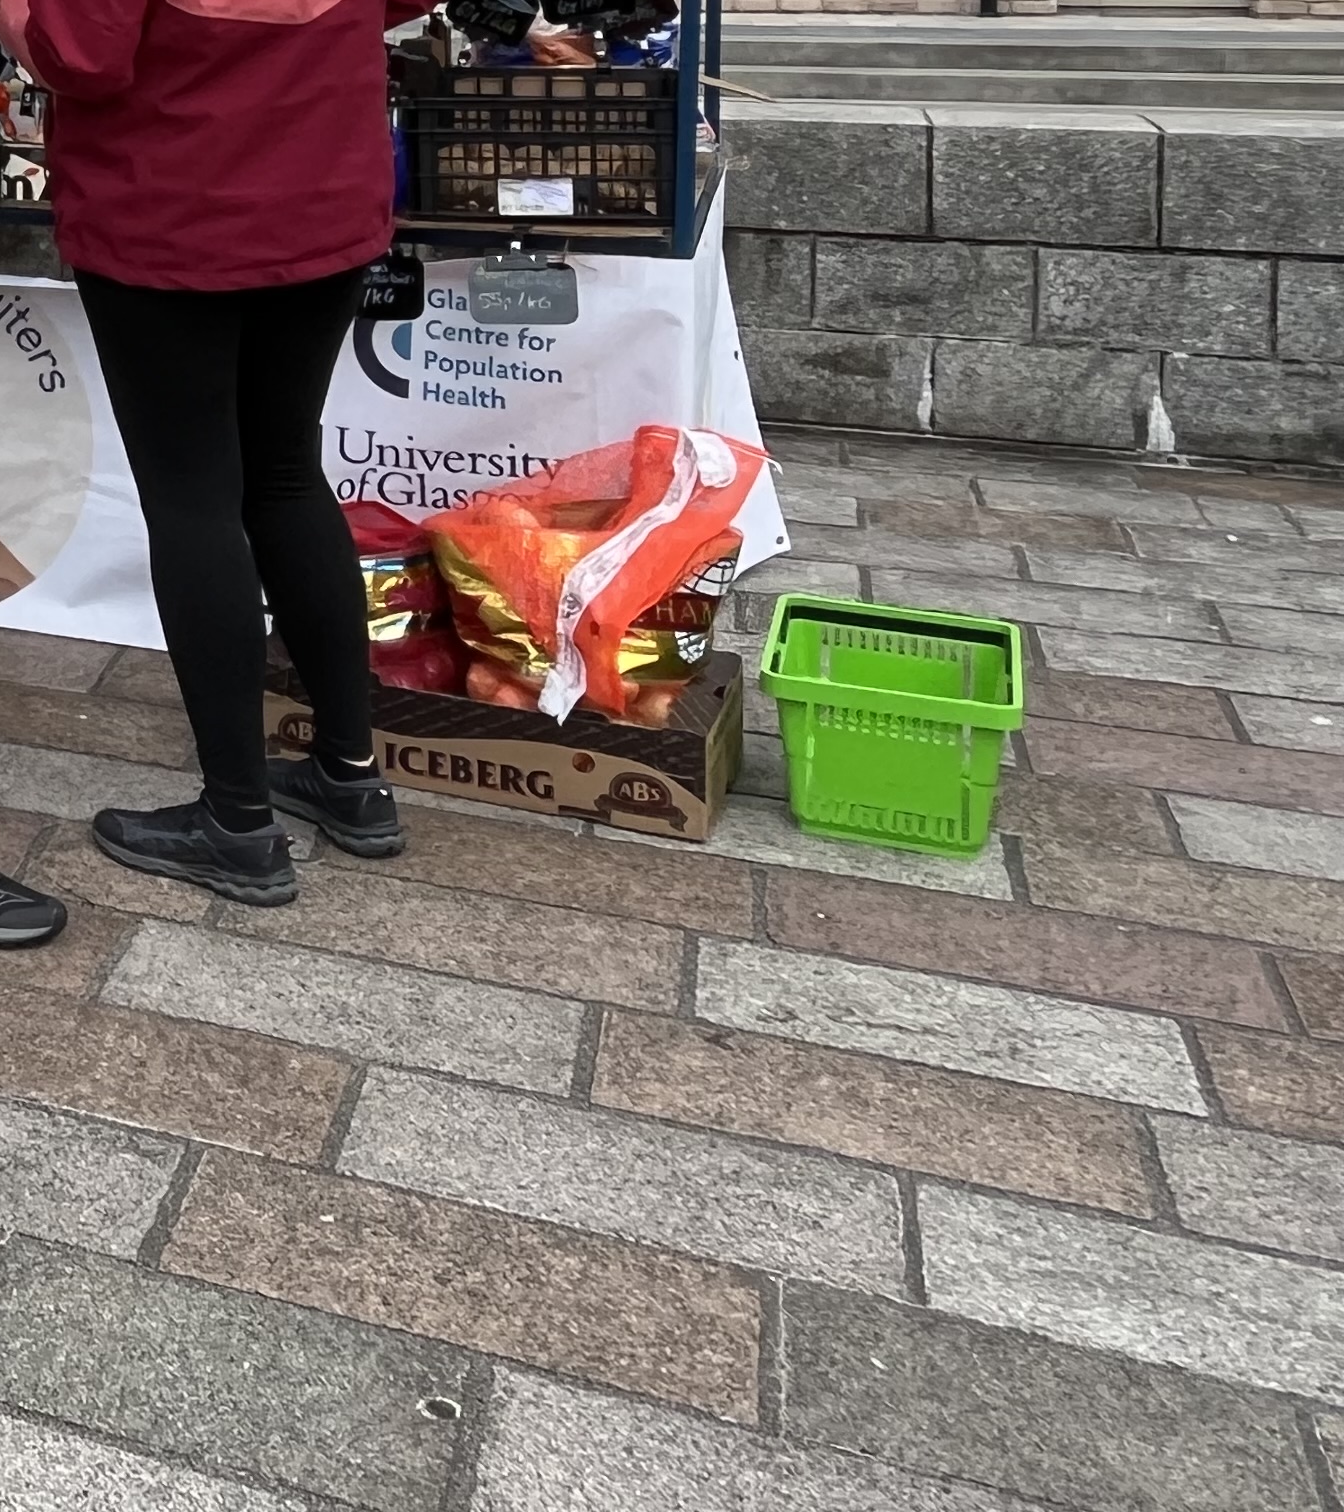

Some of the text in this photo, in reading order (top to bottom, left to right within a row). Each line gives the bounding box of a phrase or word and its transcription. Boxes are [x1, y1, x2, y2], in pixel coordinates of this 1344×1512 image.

[425, 319, 557, 354] Centre for
[424, 350, 563, 385] Population
[423, 381, 507, 410] Health
[335, 425, 567, 481] University
[336, 467, 538, 511] of Glas
[286, 720, 315, 740] AB
[384, 741, 554, 800] ICEBERG
